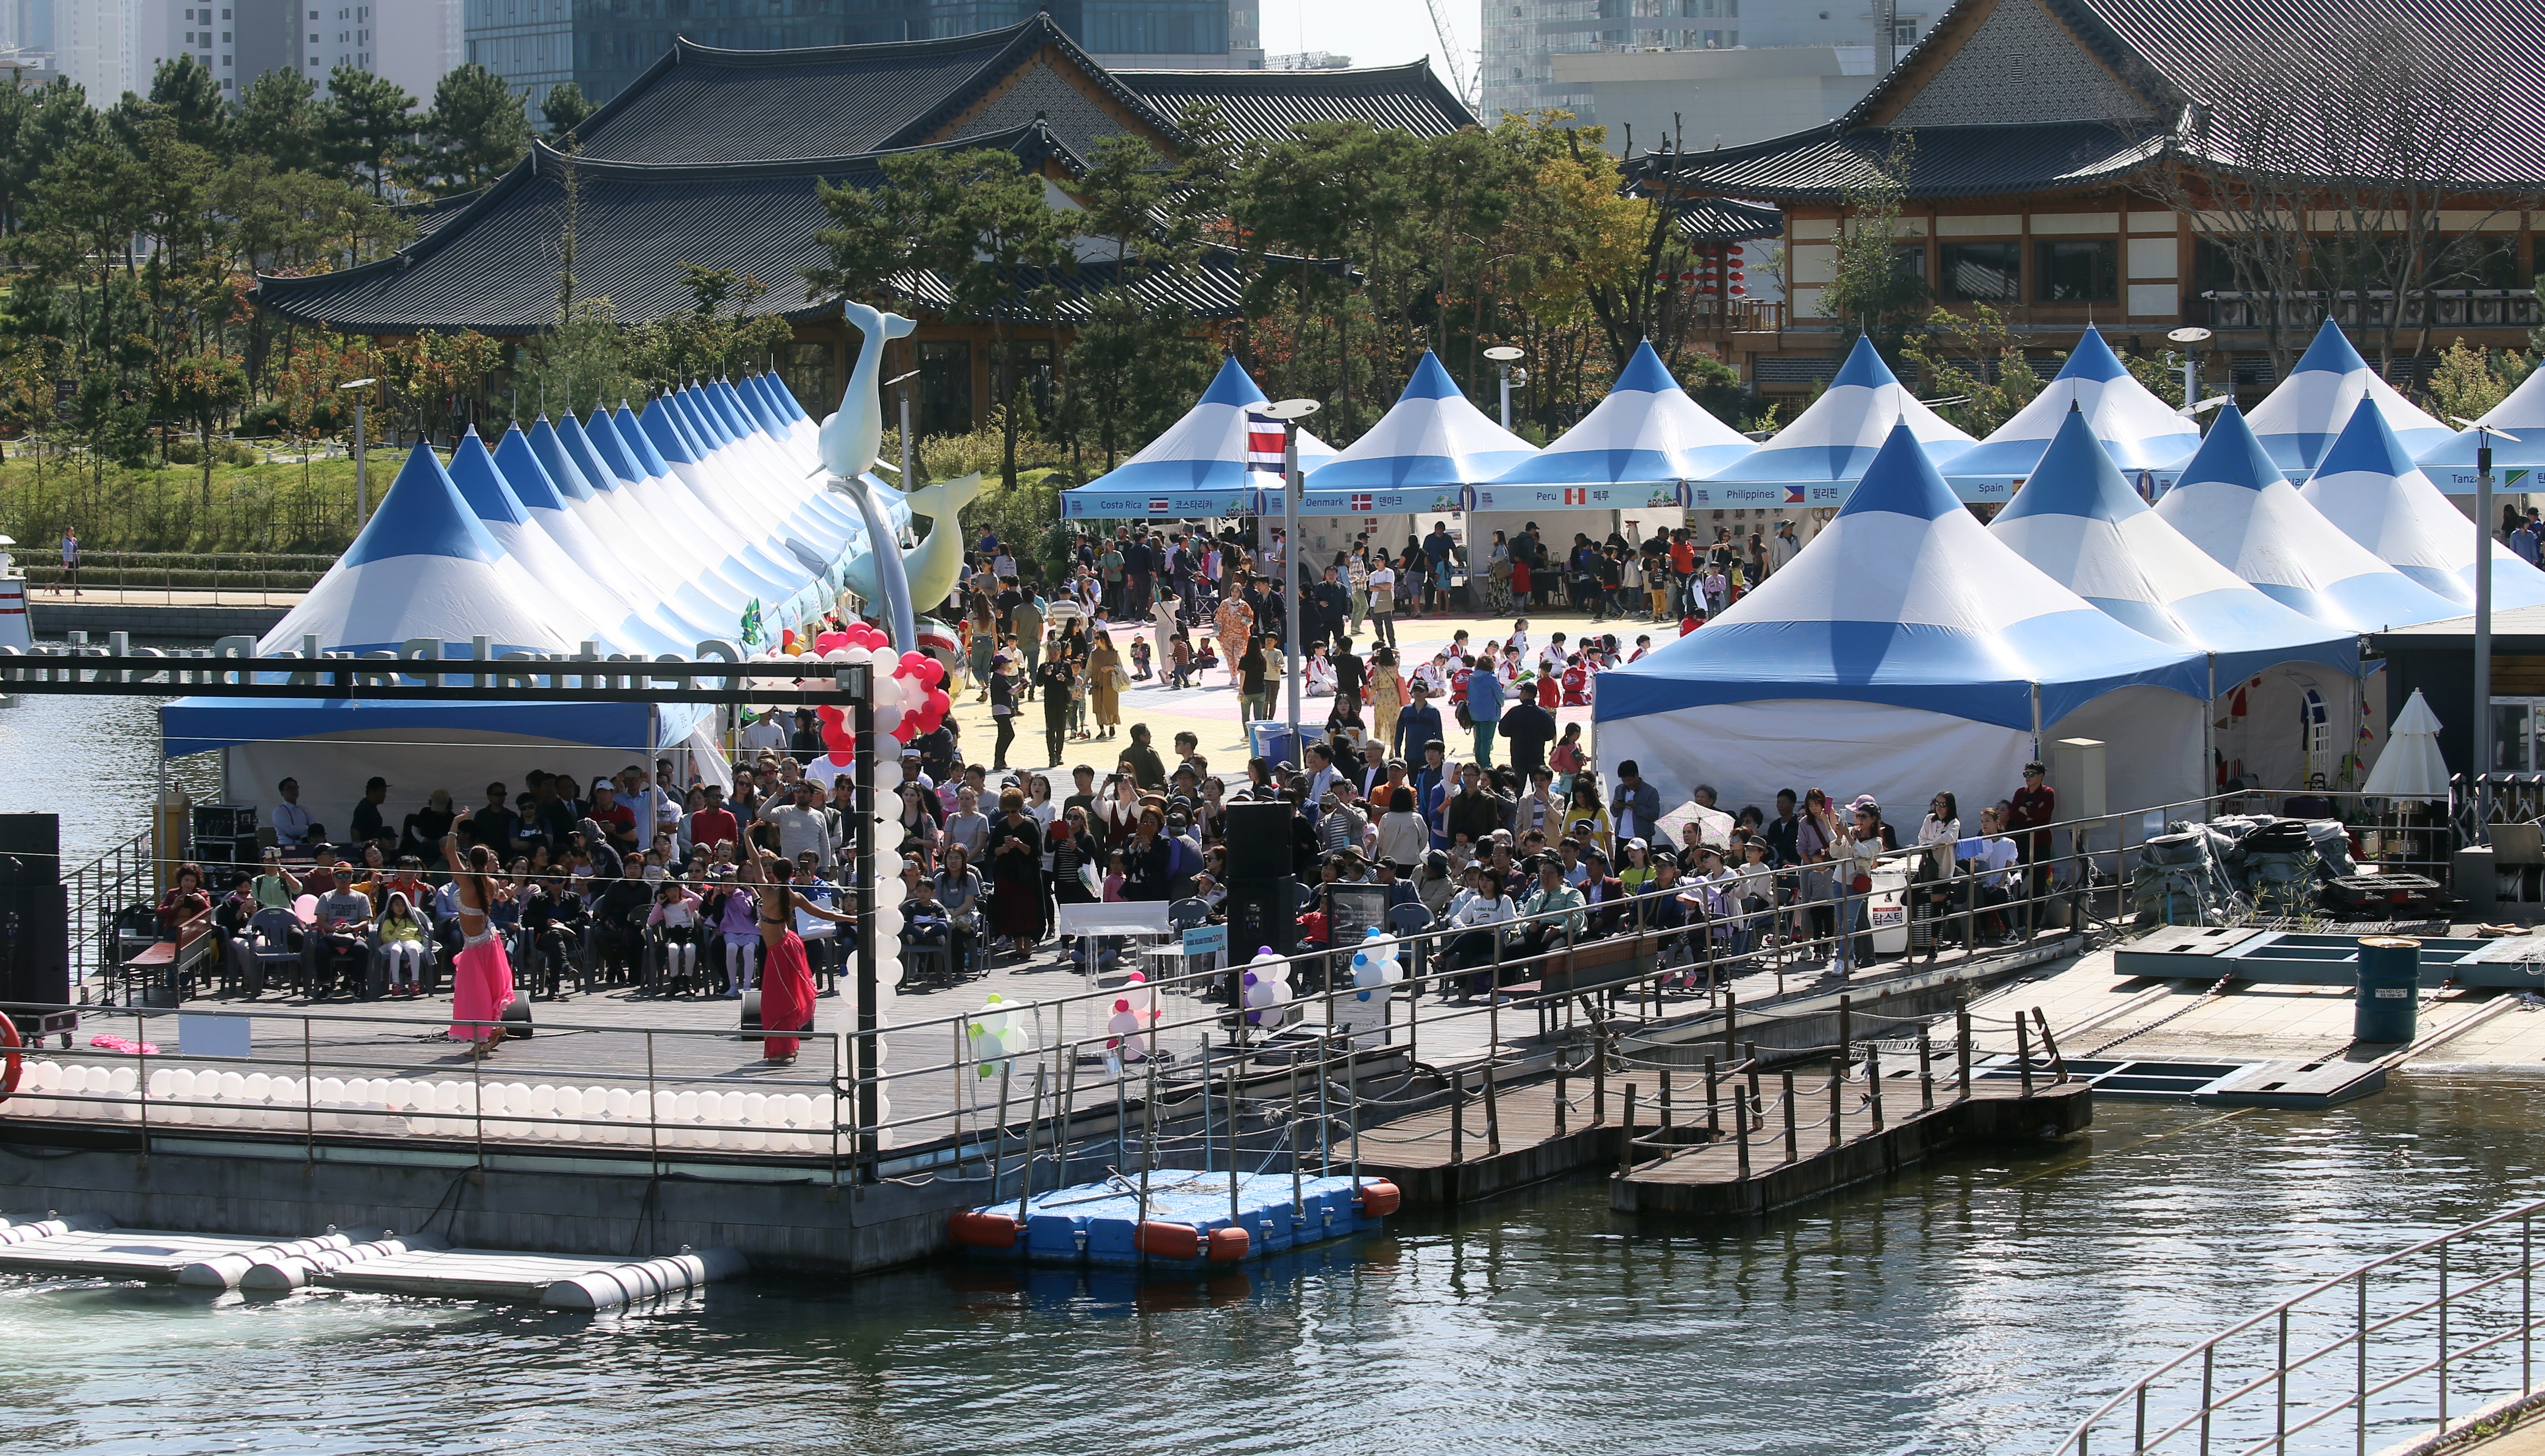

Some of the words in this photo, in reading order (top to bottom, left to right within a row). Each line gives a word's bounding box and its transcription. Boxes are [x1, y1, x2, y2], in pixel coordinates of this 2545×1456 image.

[2452, 474, 2495, 483] Tanza
[1812, 487, 1838, 499] 필리핀
[1979, 483, 2004, 494] Spain
[1537, 492, 1556, 501] Peru
[1593, 490, 1610, 501] 페루
[1727, 489, 1775, 501] Philippines
[1126, 501, 1141, 509] Rica
[1175, 500, 1213, 510] 코스타리카
[1306, 498, 1344, 506] Denmark
[1379, 496, 1402, 506] 덴마크
[1873, 912, 1902, 925] 탑스틱
[1213, 933, 1223, 942] 2019
